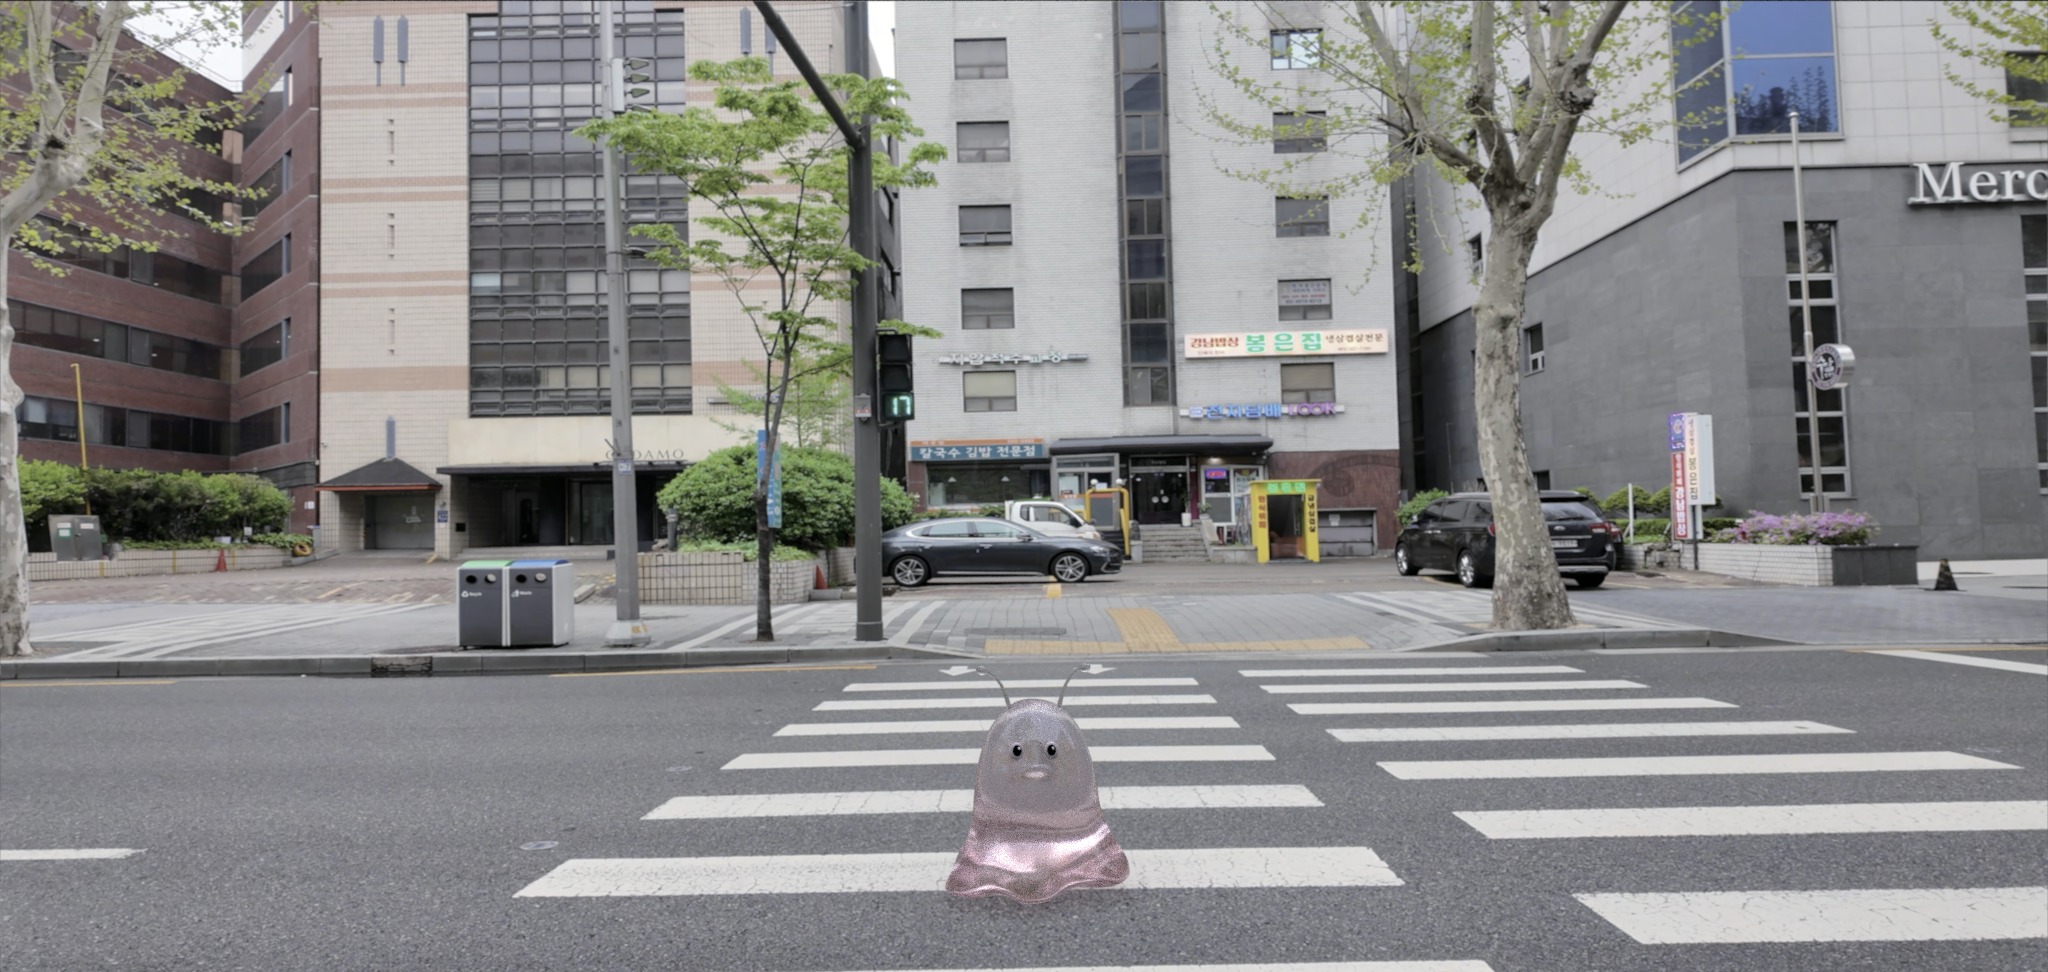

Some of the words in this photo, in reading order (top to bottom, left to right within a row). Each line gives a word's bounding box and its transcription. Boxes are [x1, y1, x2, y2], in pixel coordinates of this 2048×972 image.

[1912, 161, 2048, 201] Merc
[1190, 337, 1239, 348] 강남밥상
[1246, 332, 1322, 353] 봉은집
[893, 395, 911, 416] 17
[1206, 403, 1281, 419] 전자담배
[1287, 402, 1337, 417] LOOK
[920, 447, 961, 459] 칼국수
[966, 446, 992, 458] 김밥
[997, 445, 1036, 457] 전문점
